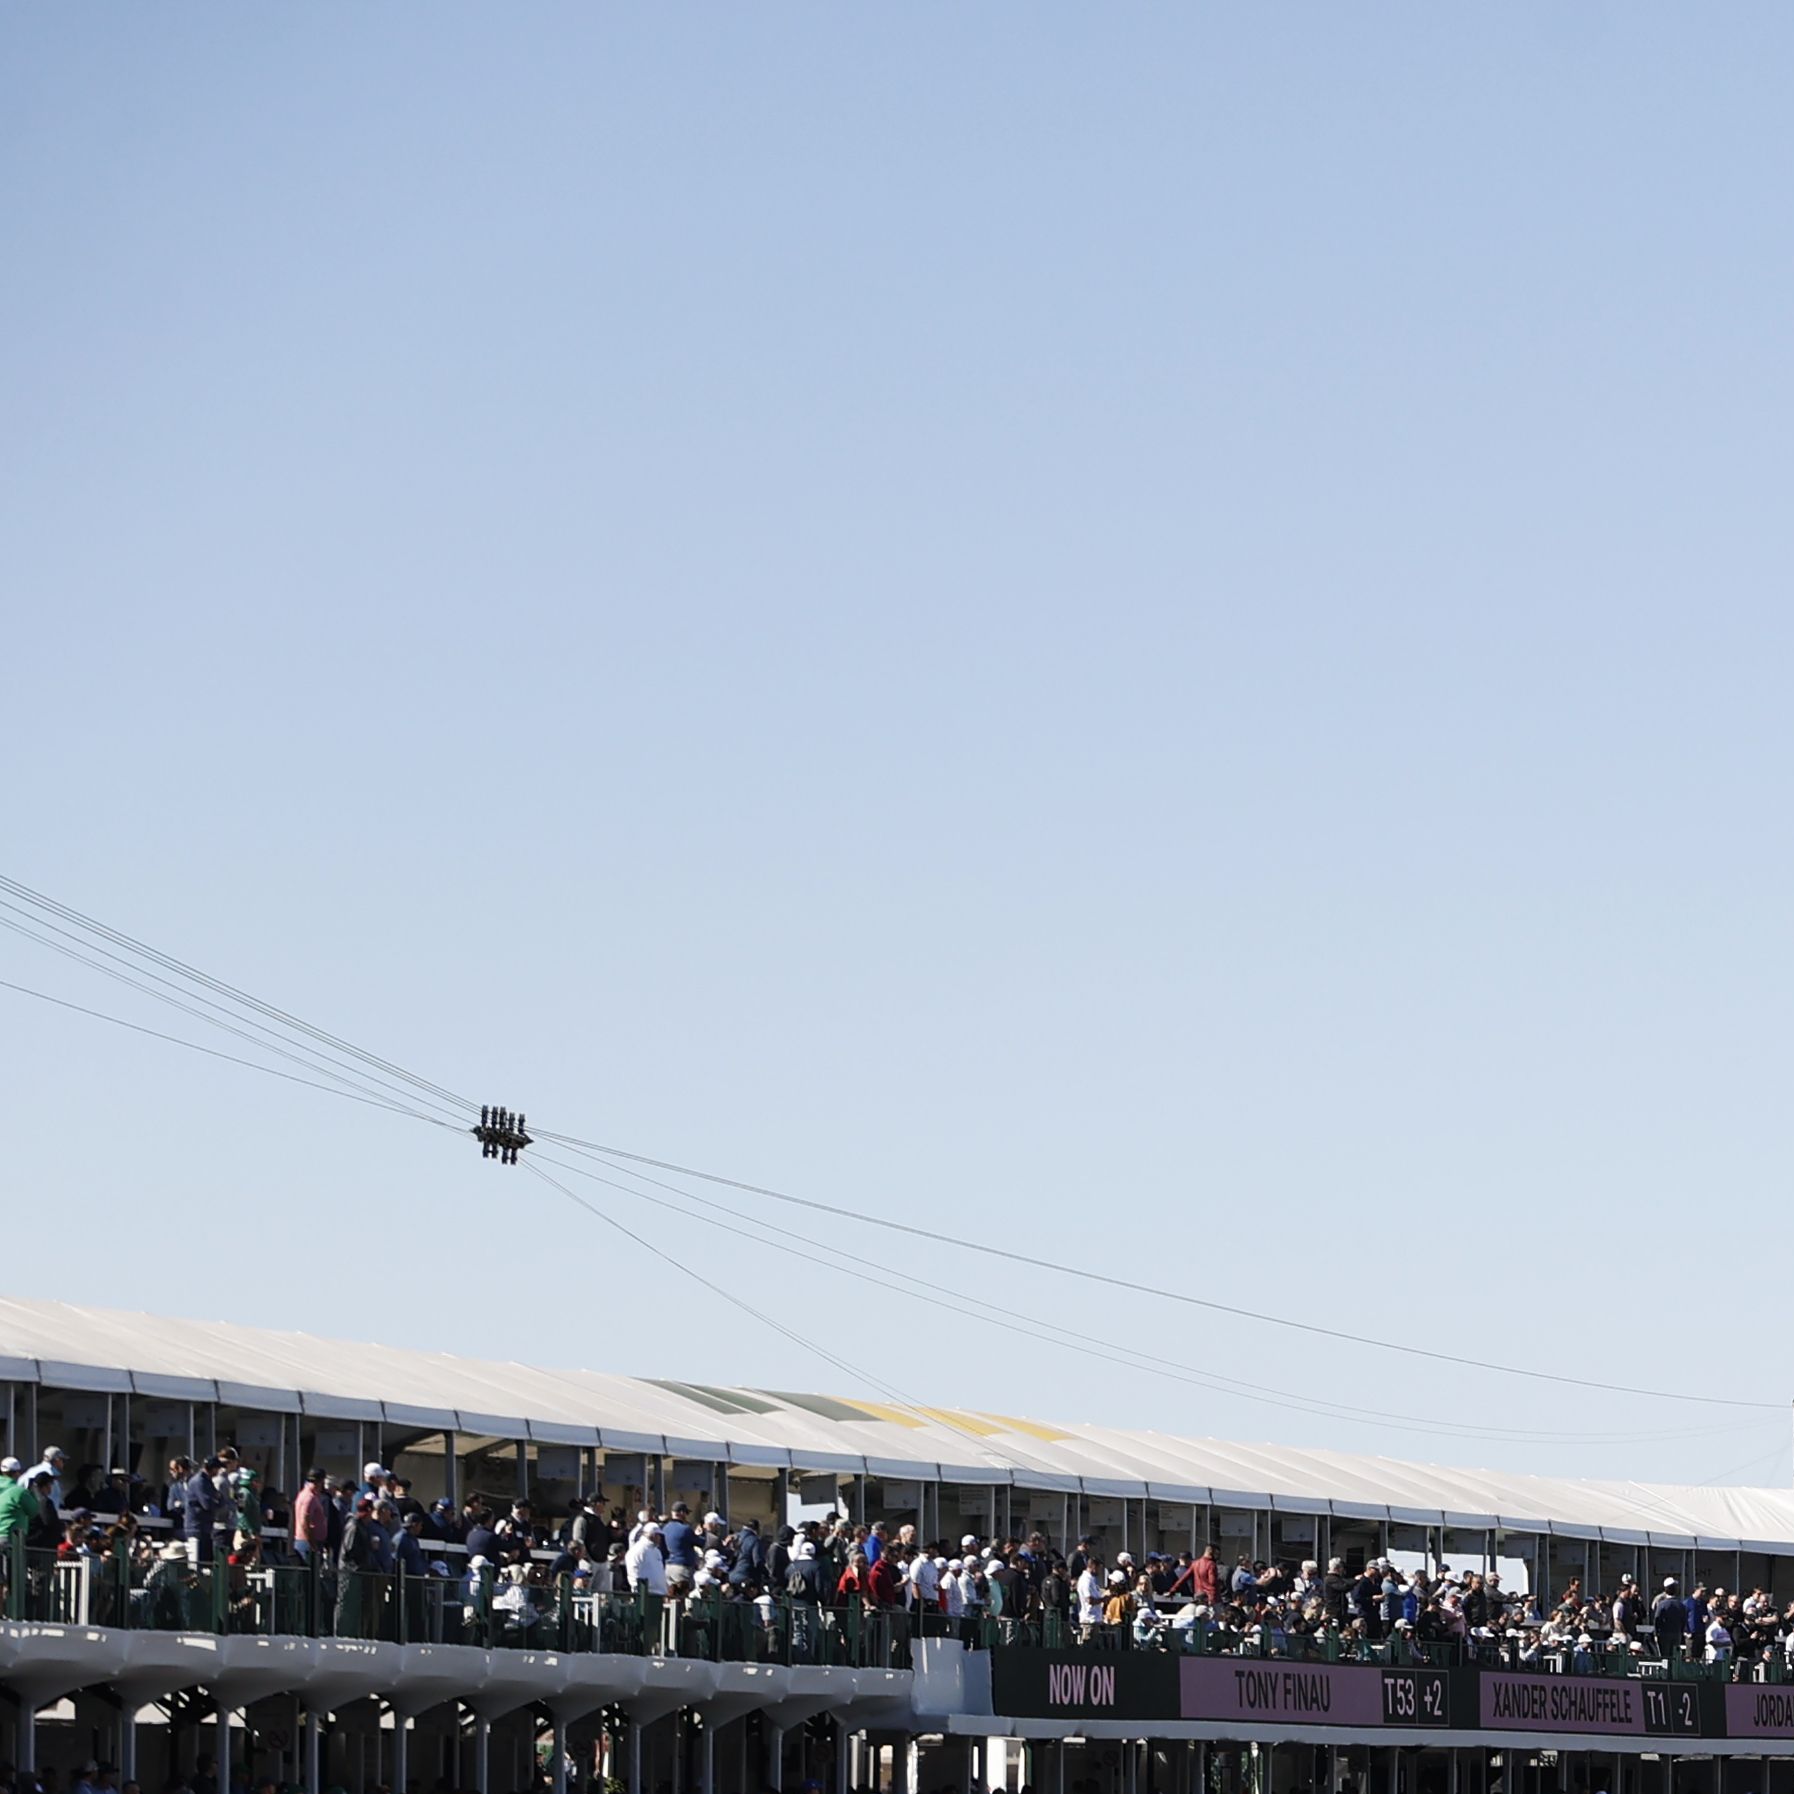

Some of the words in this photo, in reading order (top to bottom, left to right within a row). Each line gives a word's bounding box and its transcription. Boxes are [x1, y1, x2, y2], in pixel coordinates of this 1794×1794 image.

[1049, 1664, 1086, 1705] NOW
[1090, 1665, 1114, 1706] ON
[1235, 1669, 1279, 1710] TONY
[1283, 1672, 1330, 1713] FINAU
[1384, 1677, 1415, 1715] T53
[1424, 1681, 1443, 1716] +2
[1493, 1682, 1548, 1721] XANDER
[1551, 1685, 1633, 1724] SCHAUFFELE
[1647, 1691, 1668, 1725] T1
[1678, 1691, 1692, 1726] -2
